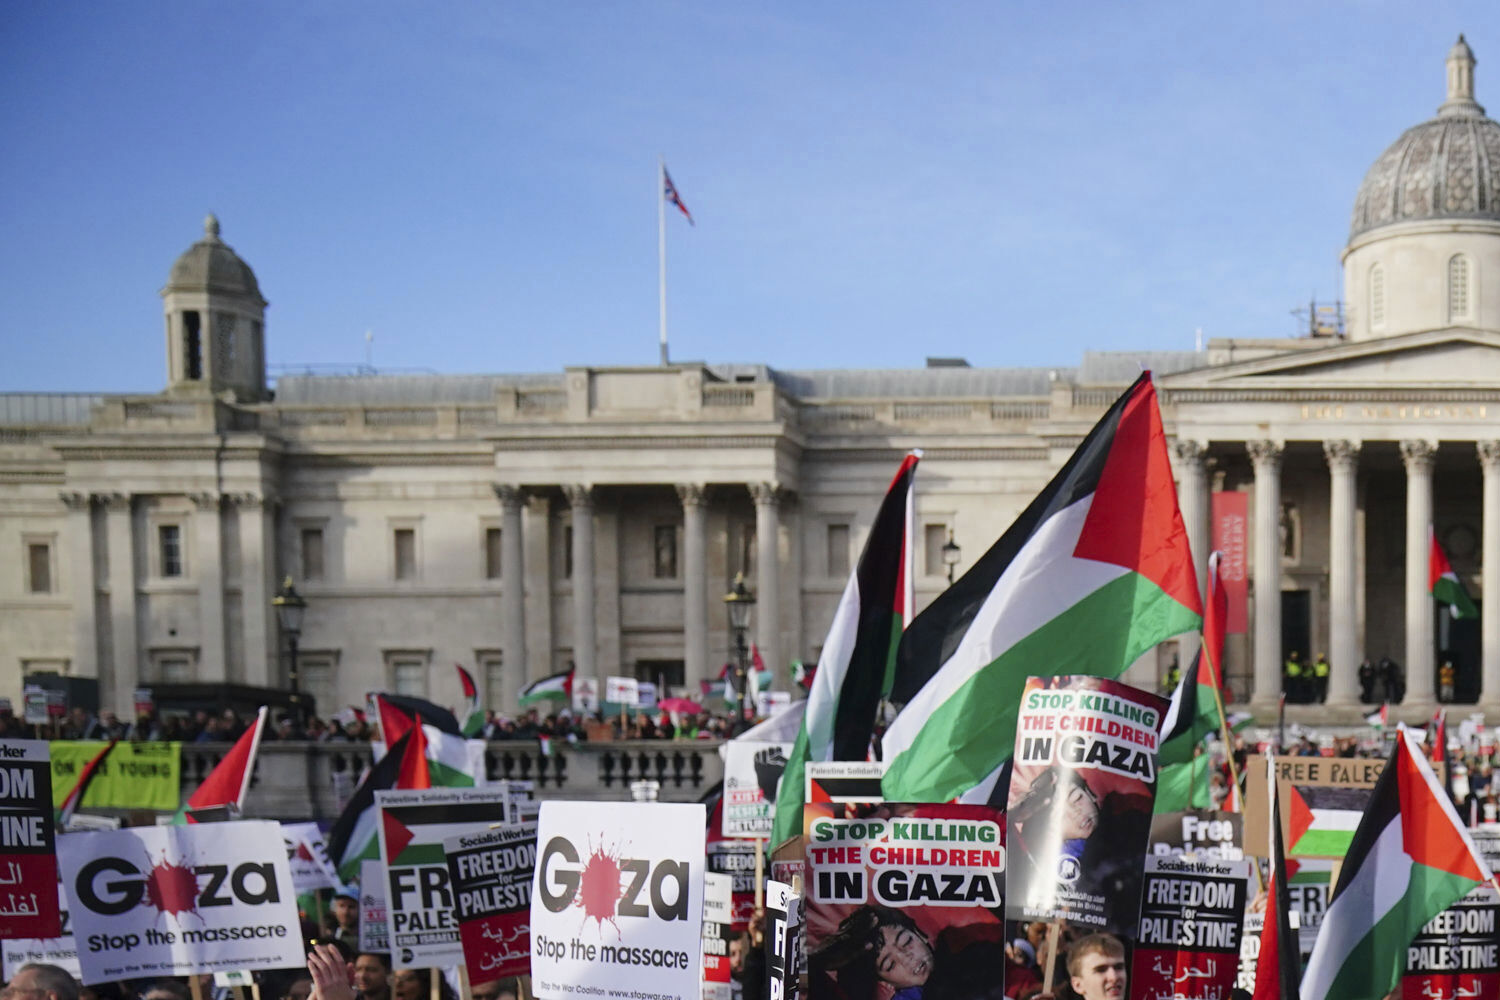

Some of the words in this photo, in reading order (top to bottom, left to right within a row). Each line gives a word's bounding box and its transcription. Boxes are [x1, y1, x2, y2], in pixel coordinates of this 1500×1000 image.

[1028, 692, 1074, 710] STOP
[1079, 694, 1156, 728] KILLING
[1023, 715, 1054, 731] THE
[1060, 715, 1156, 750] CHILDREN
[1022, 737, 1052, 761] IN
[1060, 735, 1151, 779] GAZA
[460, 833, 502, 848] Socialist
[502, 828, 537, 842] Worker
[815, 822, 885, 842] STOP
[893, 823, 996, 843] KILLING
[1181, 816, 1233, 842] Free
[811, 847, 861, 865] THE
[869, 846, 1001, 868] CHILDREN
[1157, 860, 1195, 873] Socialist
[1196, 862, 1232, 875] Worker
[75, 856, 281, 916] Gza
[498, 873, 514, 885] for
[539, 836, 690, 921] Gza
[818, 871, 863, 899] IN
[877, 869, 996, 903] GAZA
[1148, 879, 1236, 909] FREEDOM
[1181, 906, 1196, 919] for
[87, 932, 140, 953] Stop
[145, 929, 176, 946] the
[182, 923, 287, 944] massacre
[1140, 918, 1238, 948] PALESTINE
[536, 935, 566, 963] Stop
[571, 938, 596, 961] the
[600, 946, 689, 970] massacre
[1407, 945, 1498, 970] PALESTINE
[1153, 956, 1217, 982] الحرية
[562, 984, 575, 993] War
[576, 985, 605, 996] Coalition
